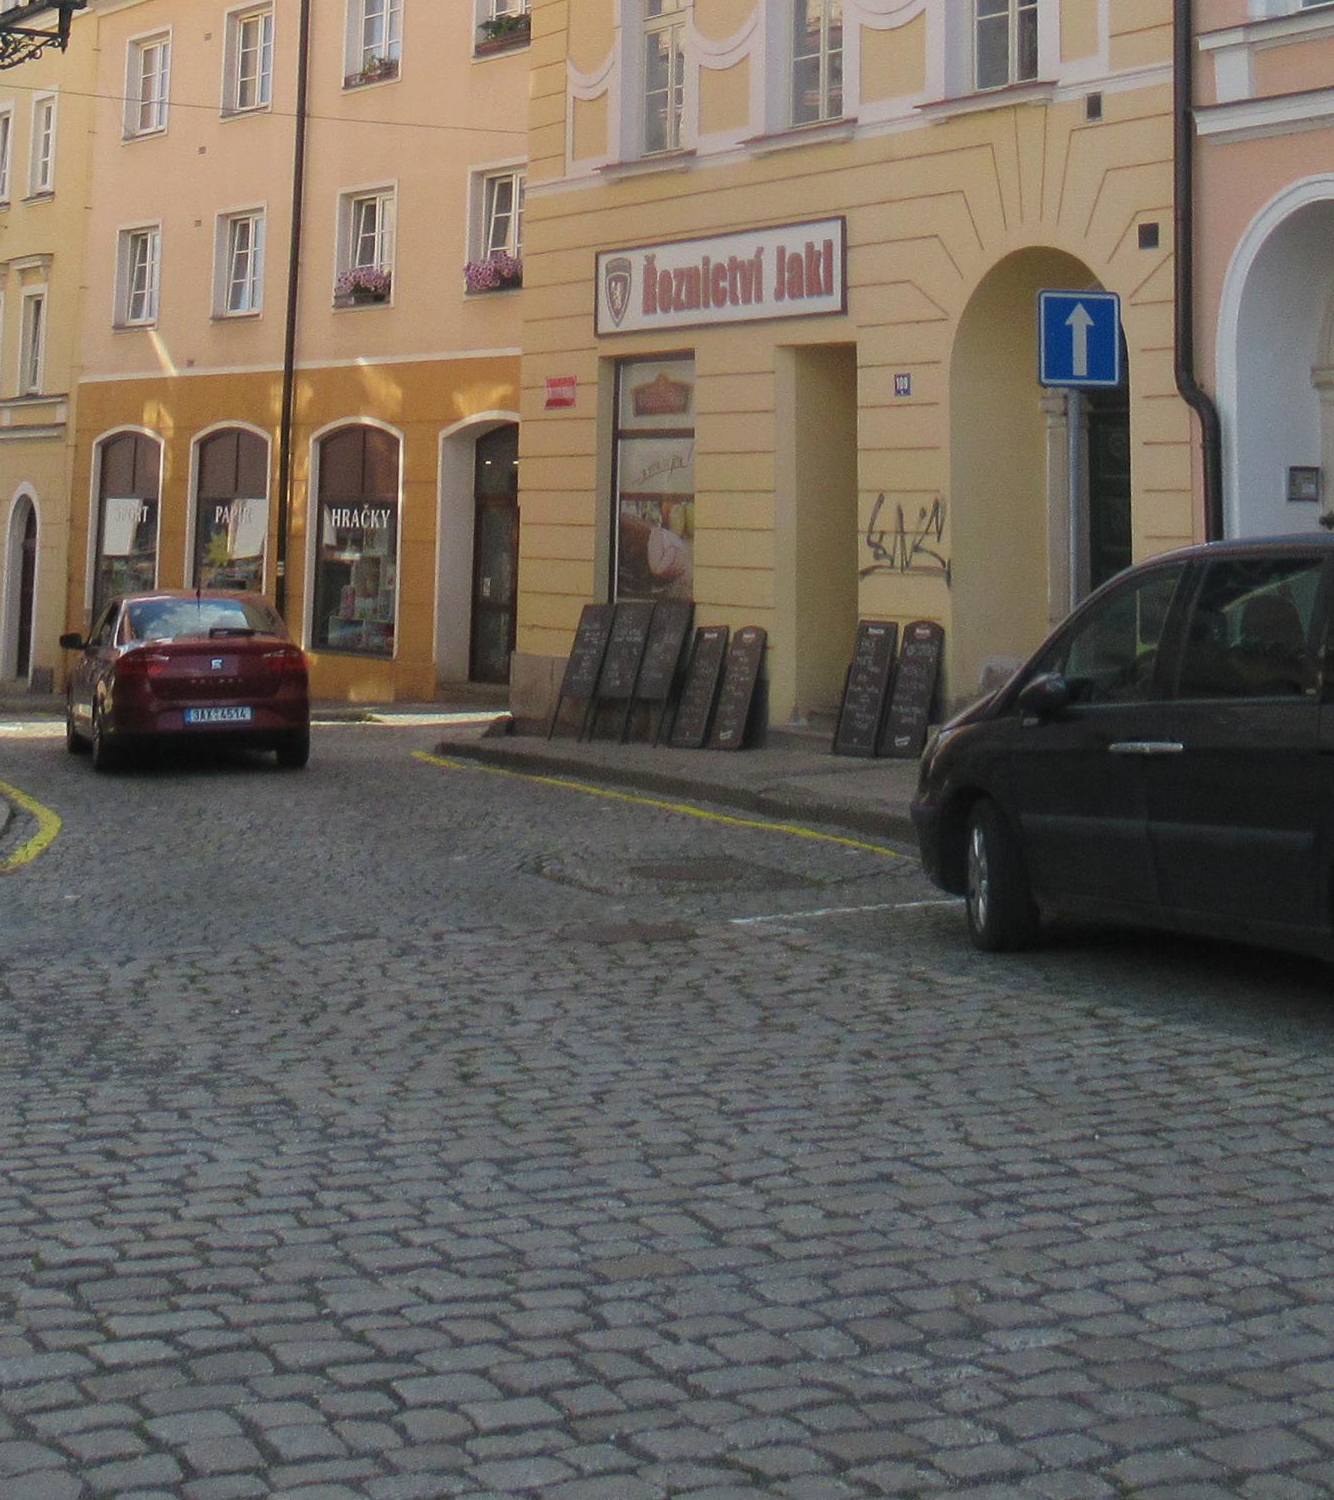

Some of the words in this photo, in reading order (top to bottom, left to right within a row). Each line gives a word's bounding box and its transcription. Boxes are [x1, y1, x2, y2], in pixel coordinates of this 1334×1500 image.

[642, 246, 765, 316] Řeznictví
[774, 239, 835, 302] Jakl
[330, 503, 391, 529] HRAČKY
